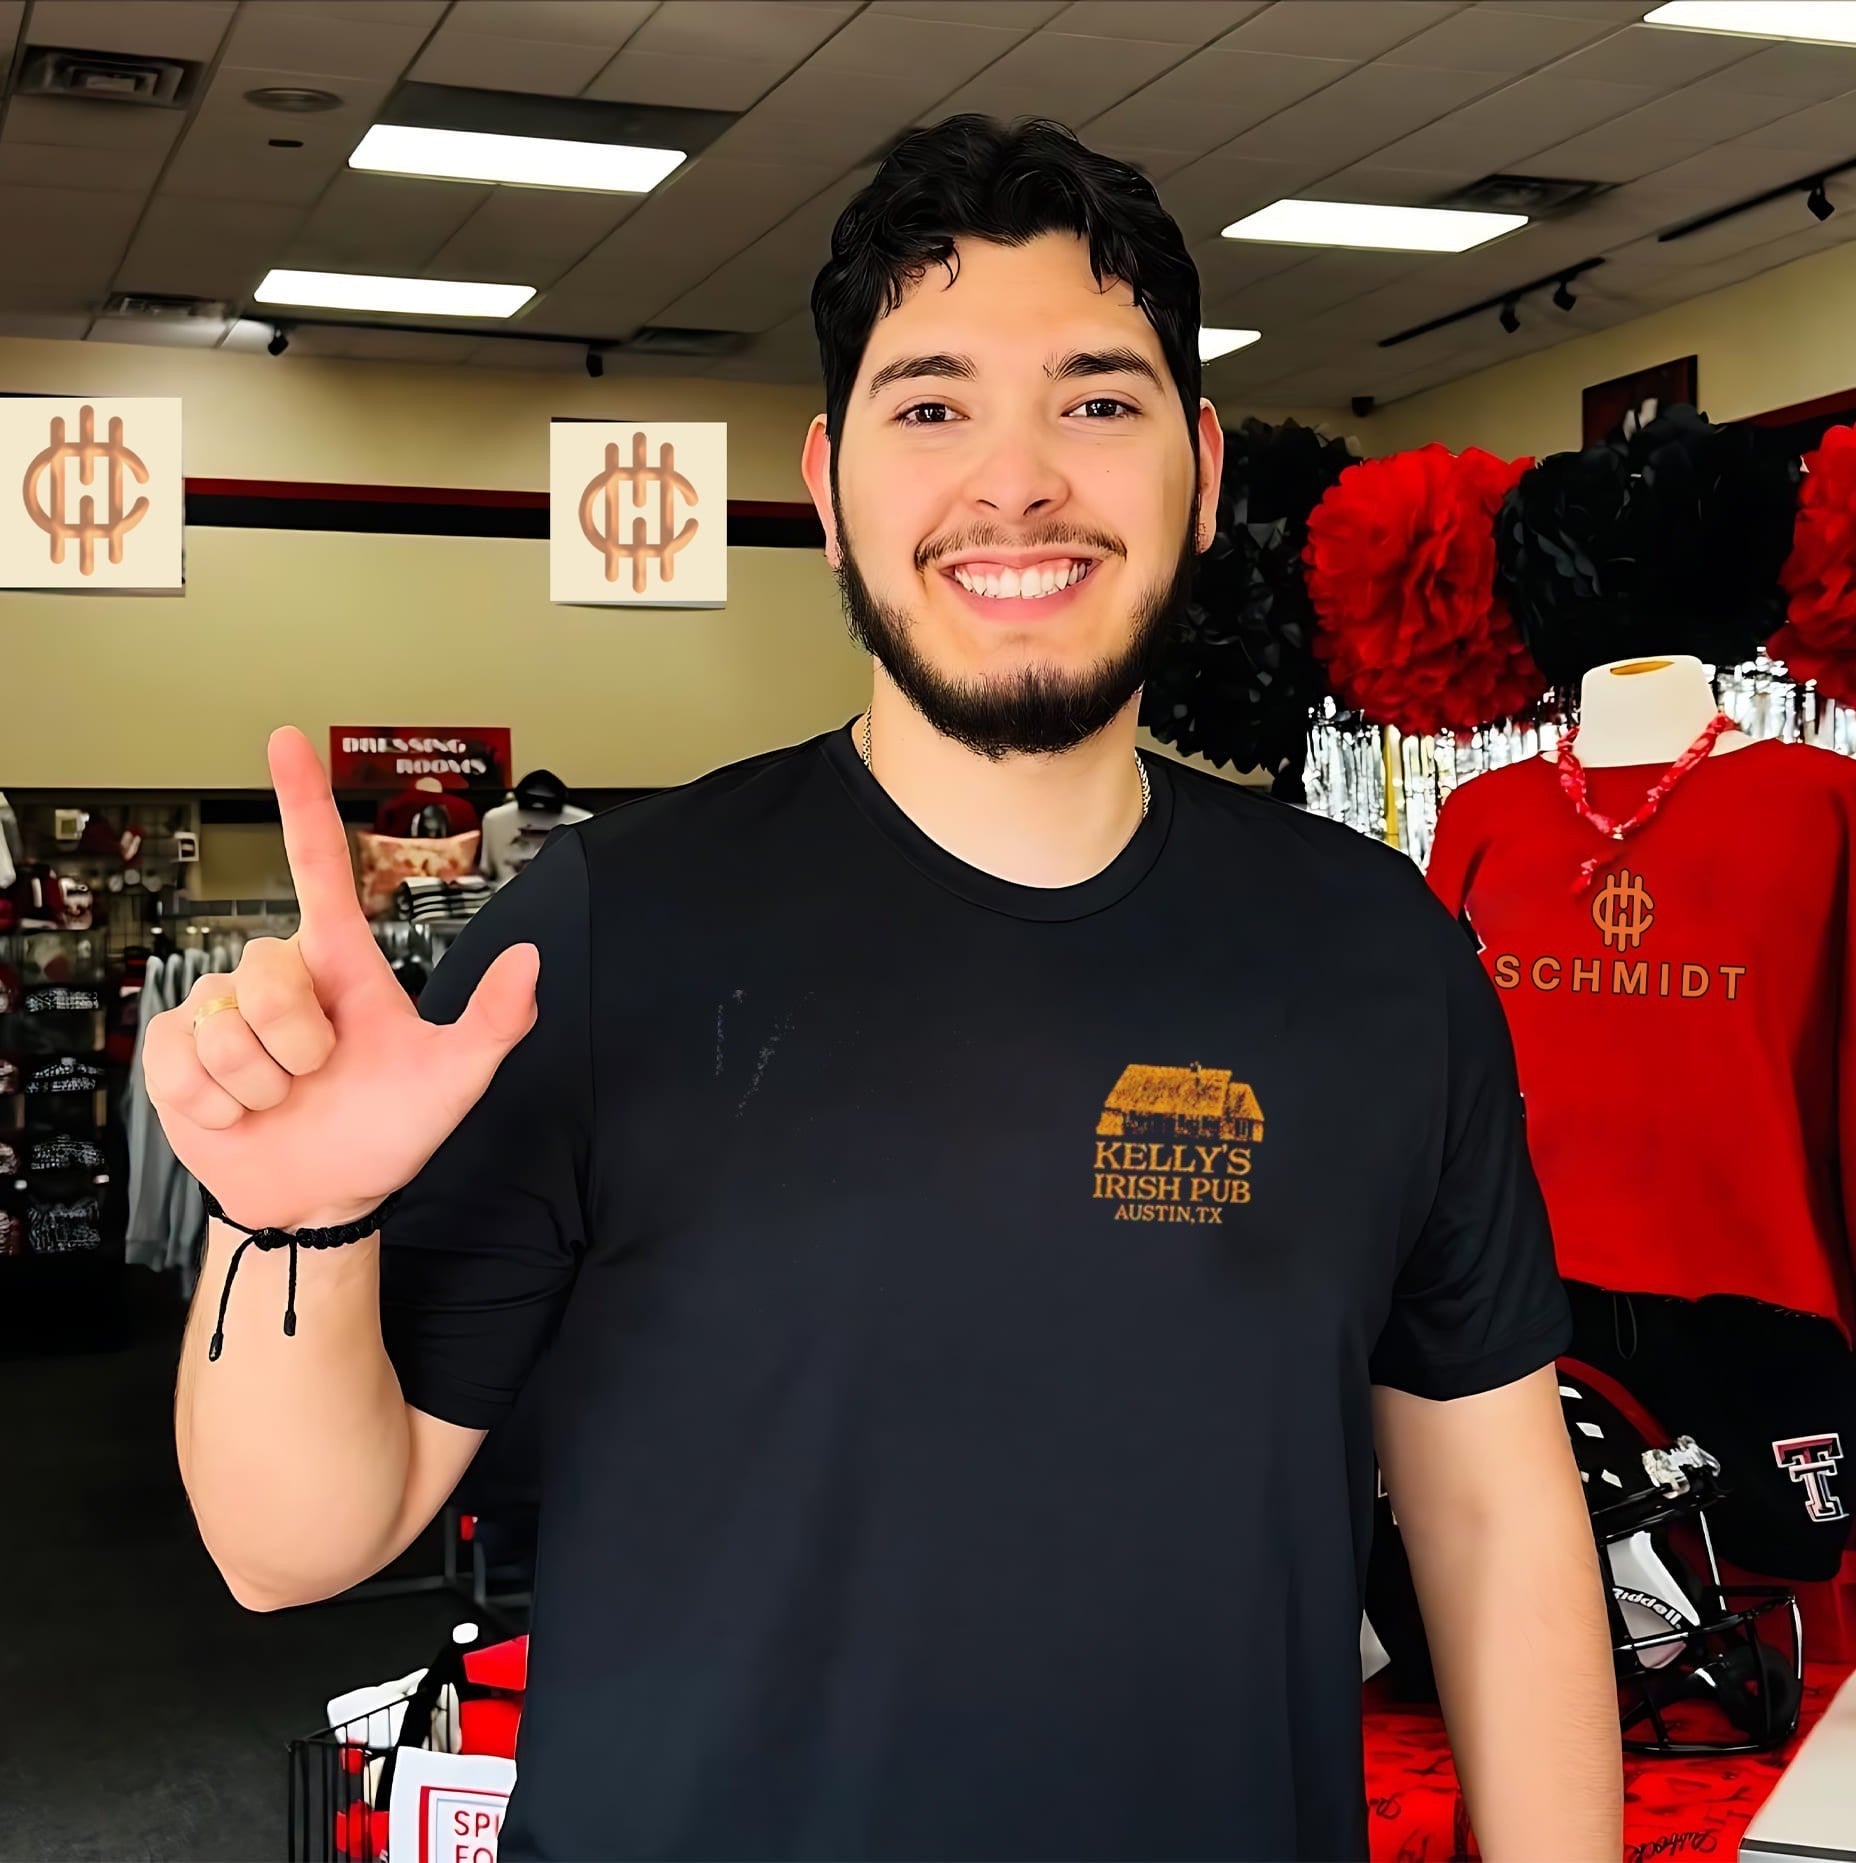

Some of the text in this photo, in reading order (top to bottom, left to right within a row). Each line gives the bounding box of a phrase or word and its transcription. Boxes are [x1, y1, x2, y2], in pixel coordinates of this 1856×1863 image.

[342, 737, 467, 753] DRESSING
[396, 758, 487, 775] ROOMS
[1494, 954, 1747, 1001] SCHMIDT
[1093, 1141, 1252, 1176] KELLY'S
[1092, 1173, 1251, 1204] IRISH PUB
